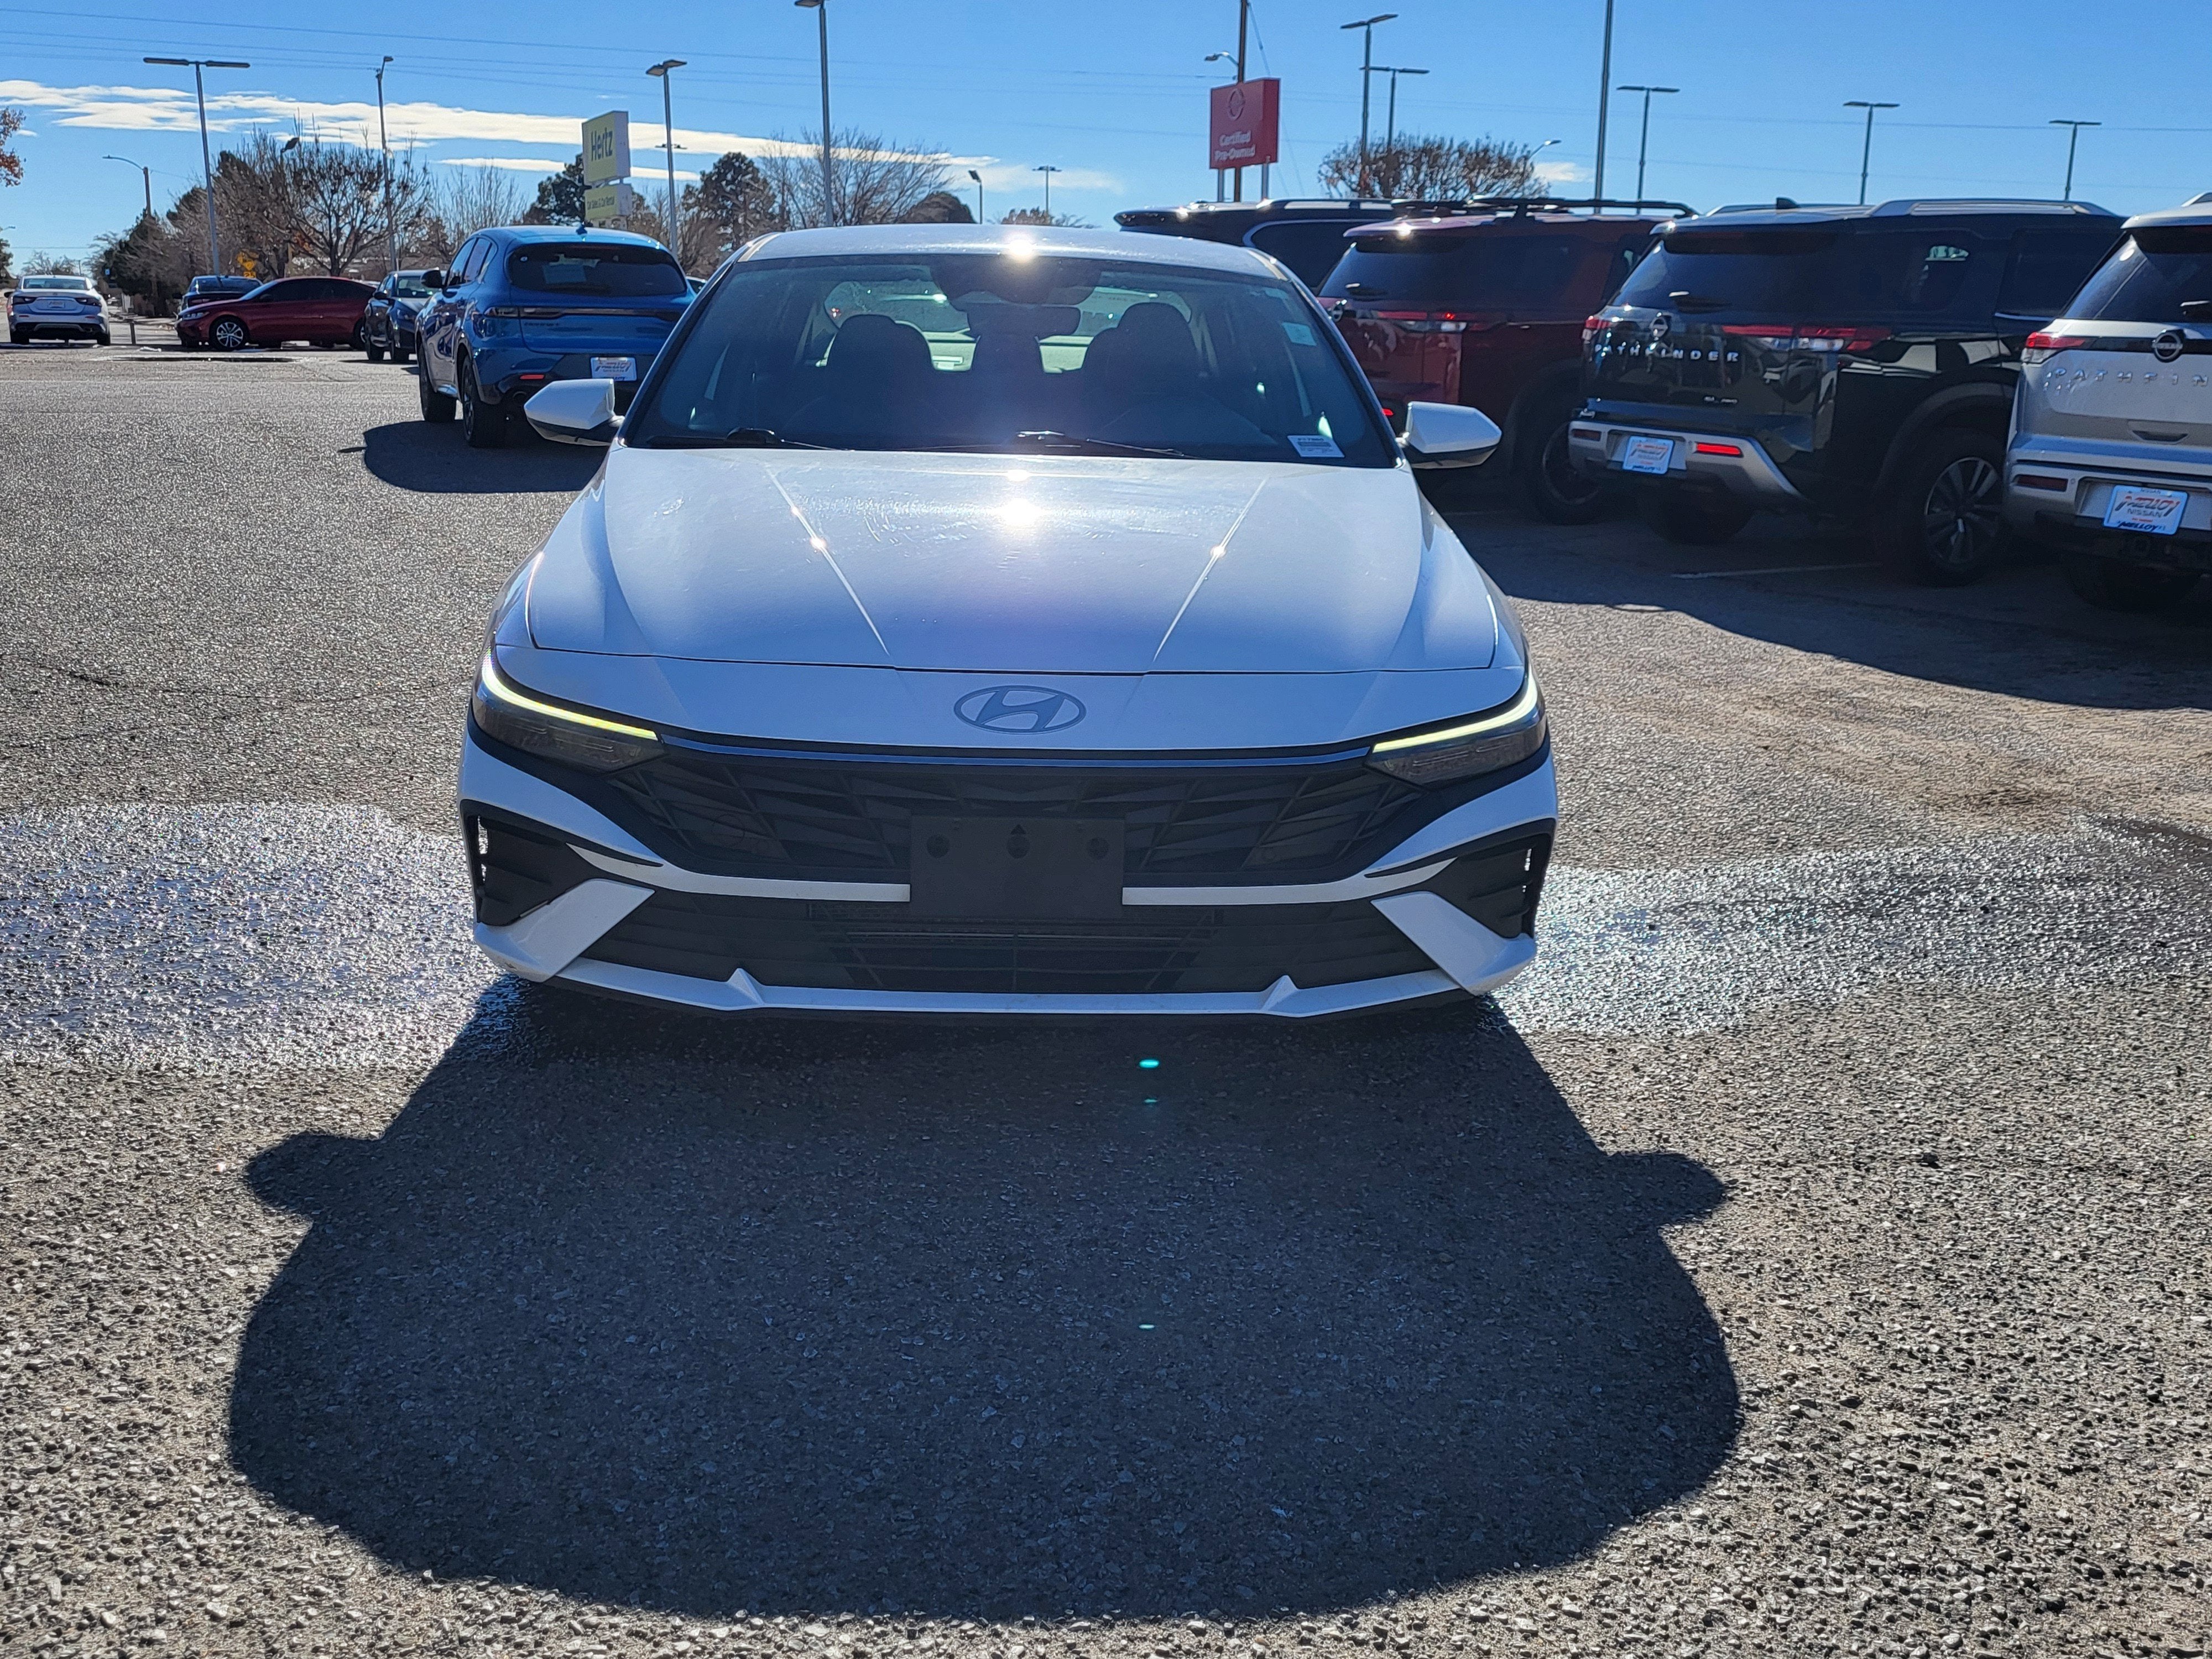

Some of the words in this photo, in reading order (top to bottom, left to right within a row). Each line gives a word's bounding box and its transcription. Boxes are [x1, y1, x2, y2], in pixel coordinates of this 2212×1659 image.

[591, 127, 613, 161] Hertz
[1220, 130, 1251, 146] Certified
[1214, 144, 1256, 161] Pre-Owned
[2127, 508, 2163, 518] NISSAN
